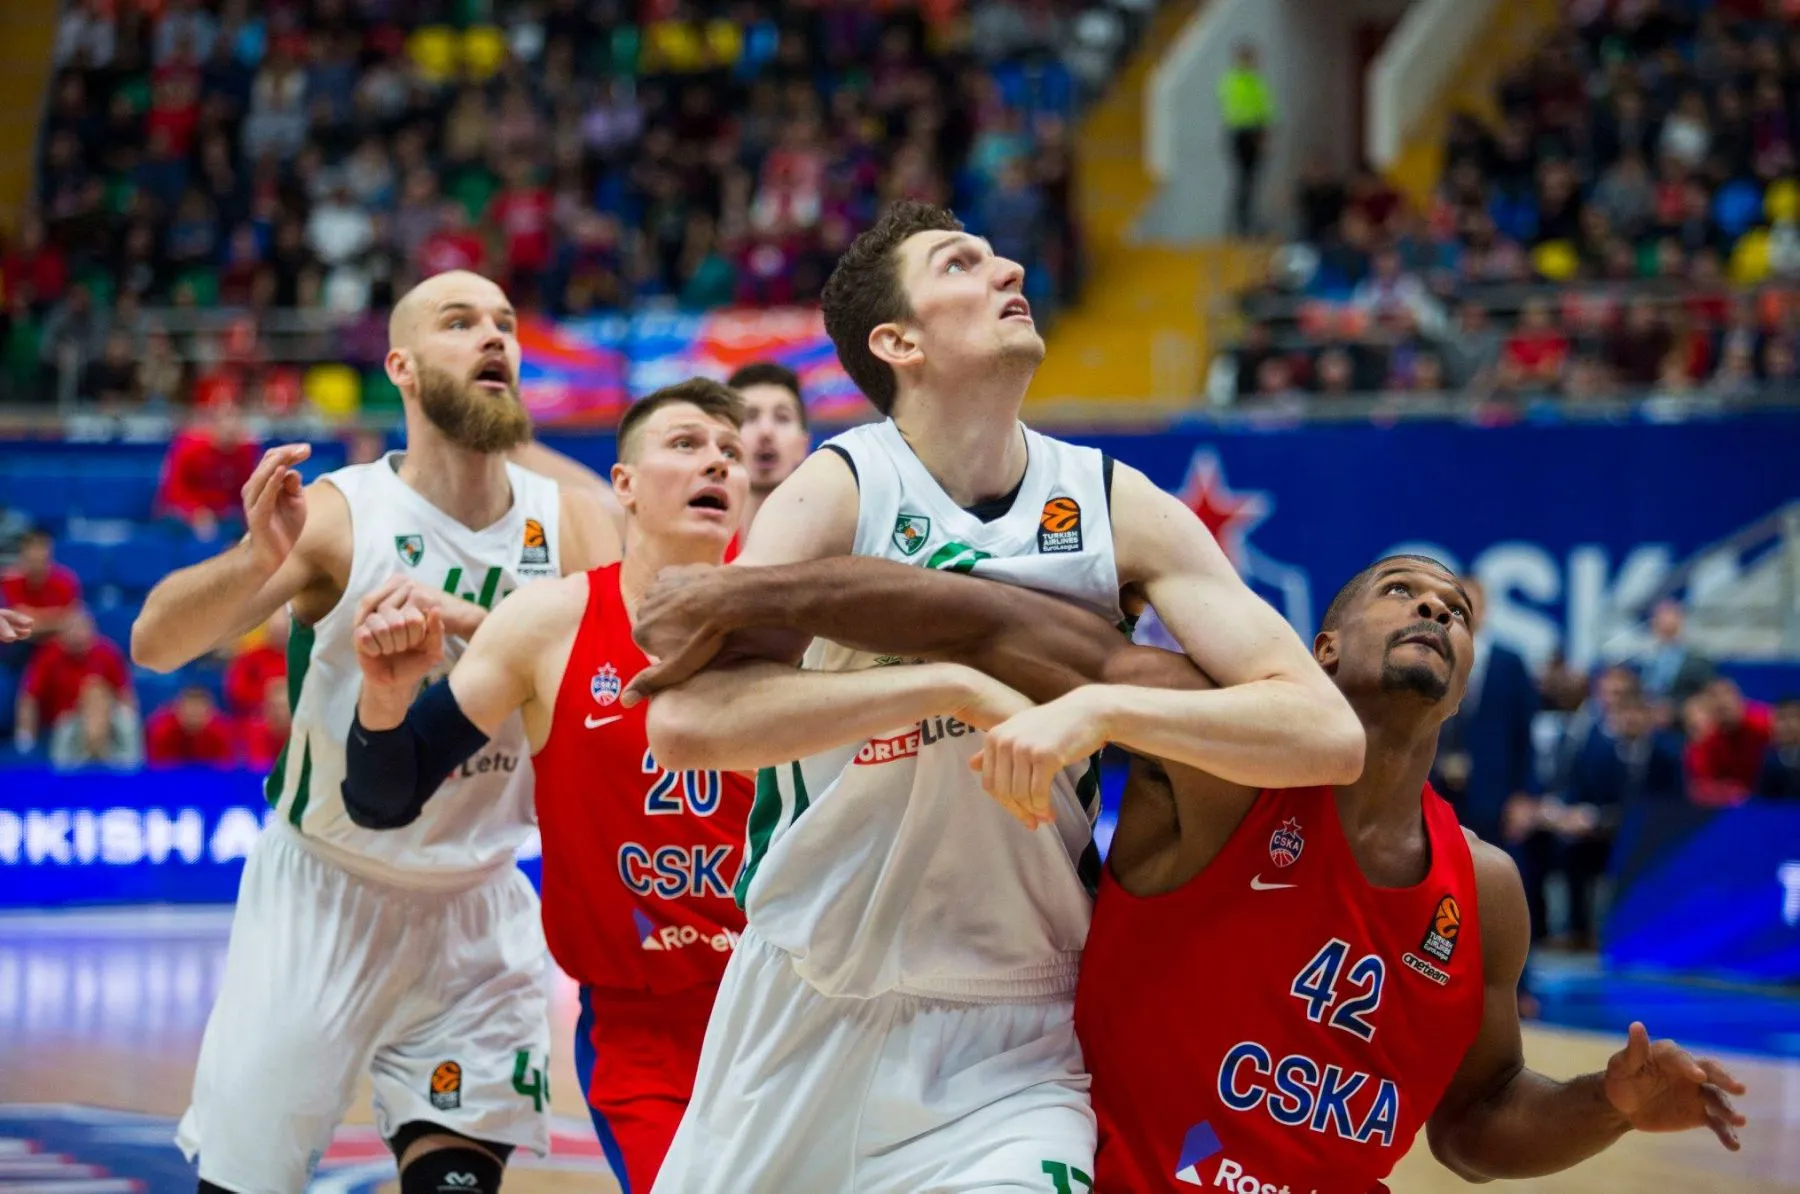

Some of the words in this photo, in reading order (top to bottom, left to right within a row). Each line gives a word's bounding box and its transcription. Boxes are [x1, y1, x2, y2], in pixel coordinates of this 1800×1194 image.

[858, 733, 920, 763] ORLE
[921, 714, 977, 746] Lie
[642, 746, 723, 817] 20
[617, 842, 748, 900] CSK
[1273, 834, 1300, 852] CSKA
[1290, 937, 1386, 1043] 42
[1402, 953, 1450, 985] oneteam
[512, 1049, 550, 1113] 4
[1217, 1041, 1399, 1146] CSKA
